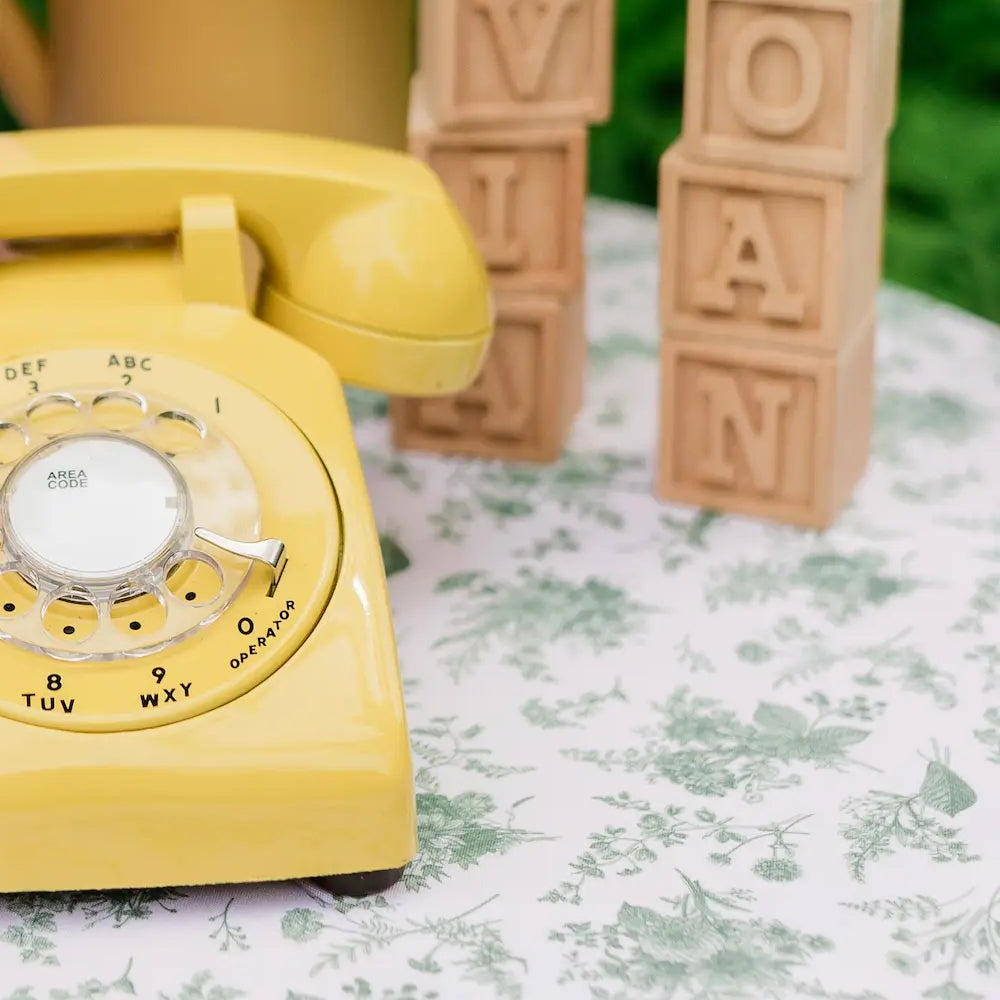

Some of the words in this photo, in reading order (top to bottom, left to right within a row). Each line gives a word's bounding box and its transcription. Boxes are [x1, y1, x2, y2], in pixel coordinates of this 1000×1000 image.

[5, 359, 48, 381] DEF
[108, 354, 152, 371] ABC
[47, 469, 87, 480] AREA
[47, 479, 88, 489] CODE
[230, 600, 295, 669] OPERATOR
[46, 673, 62, 691] 8
[151, 667, 166, 684] 9
[22, 693, 75, 713] TUV
[140, 683, 192, 708] WXY
